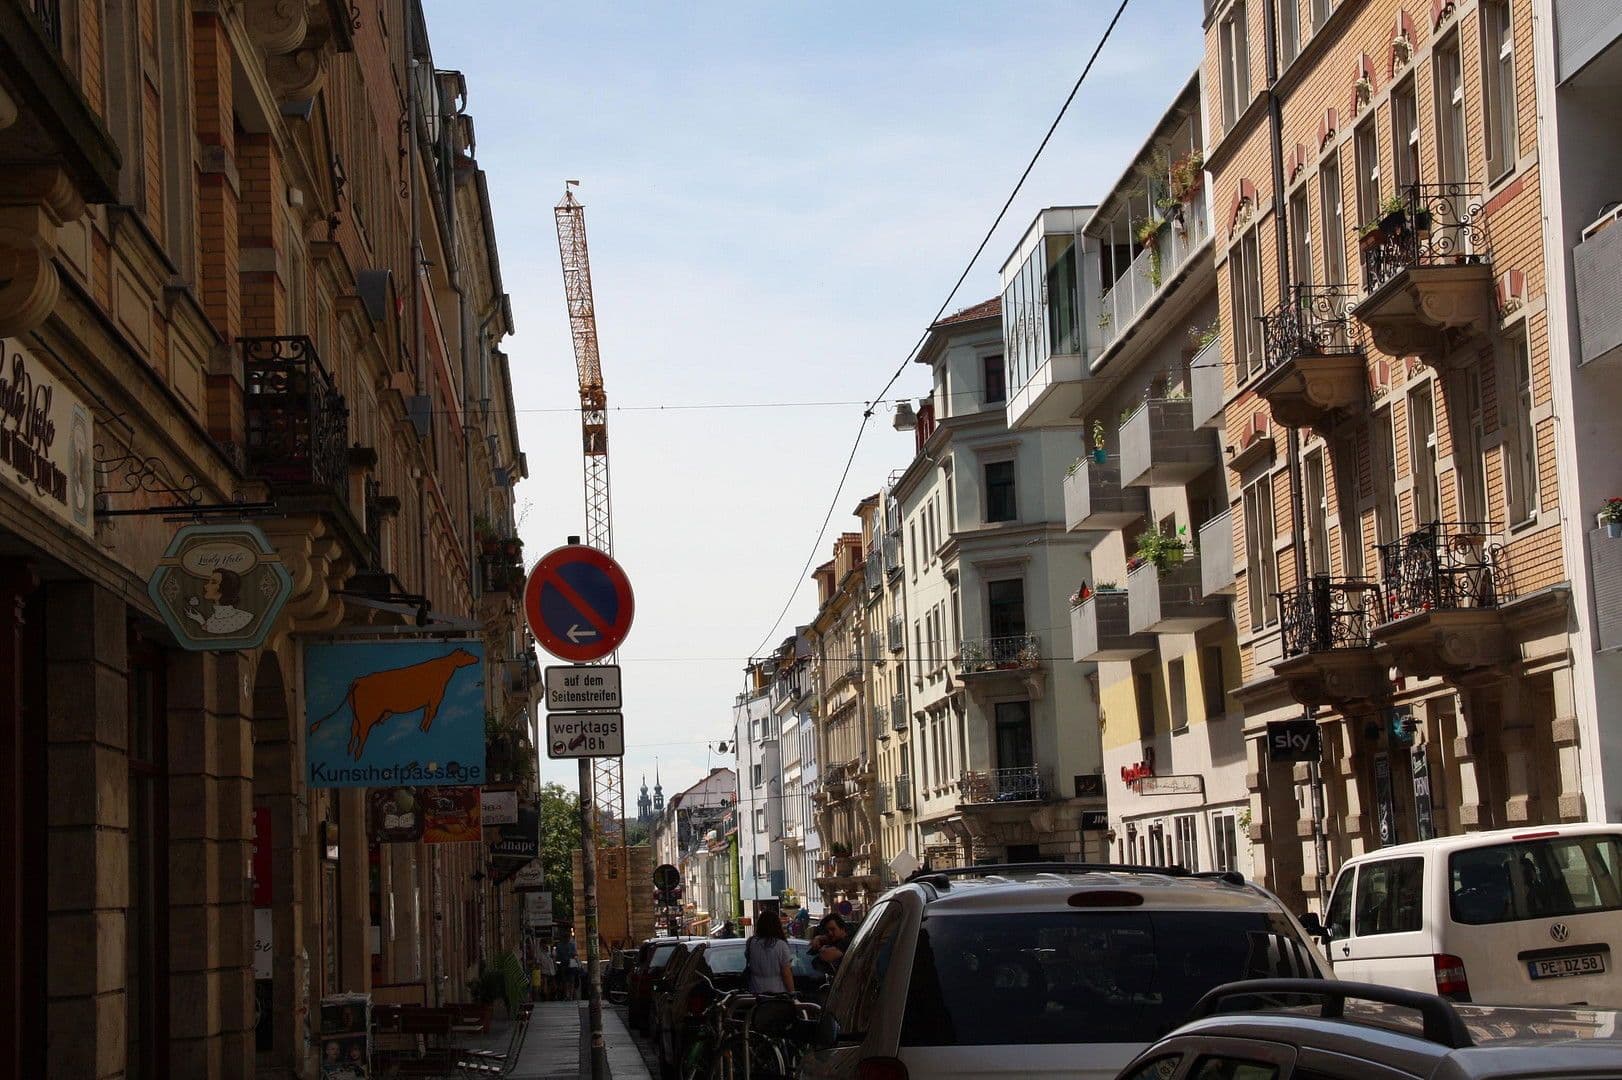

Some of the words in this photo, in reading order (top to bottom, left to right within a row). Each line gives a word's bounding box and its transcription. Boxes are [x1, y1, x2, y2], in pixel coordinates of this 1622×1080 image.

[564, 675, 579, 686] auf
[584, 675, 603, 686] dem
[552, 689, 616, 702] Seitenstreifen
[554, 721, 617, 736] werktags
[1275, 730, 1311, 751] sky
[310, 761, 481, 784] Kunsthofpassage
[1541, 961, 1557, 974] PE
[1564, 959, 1581, 972] DZ
[1581, 957, 1598, 970] 58
